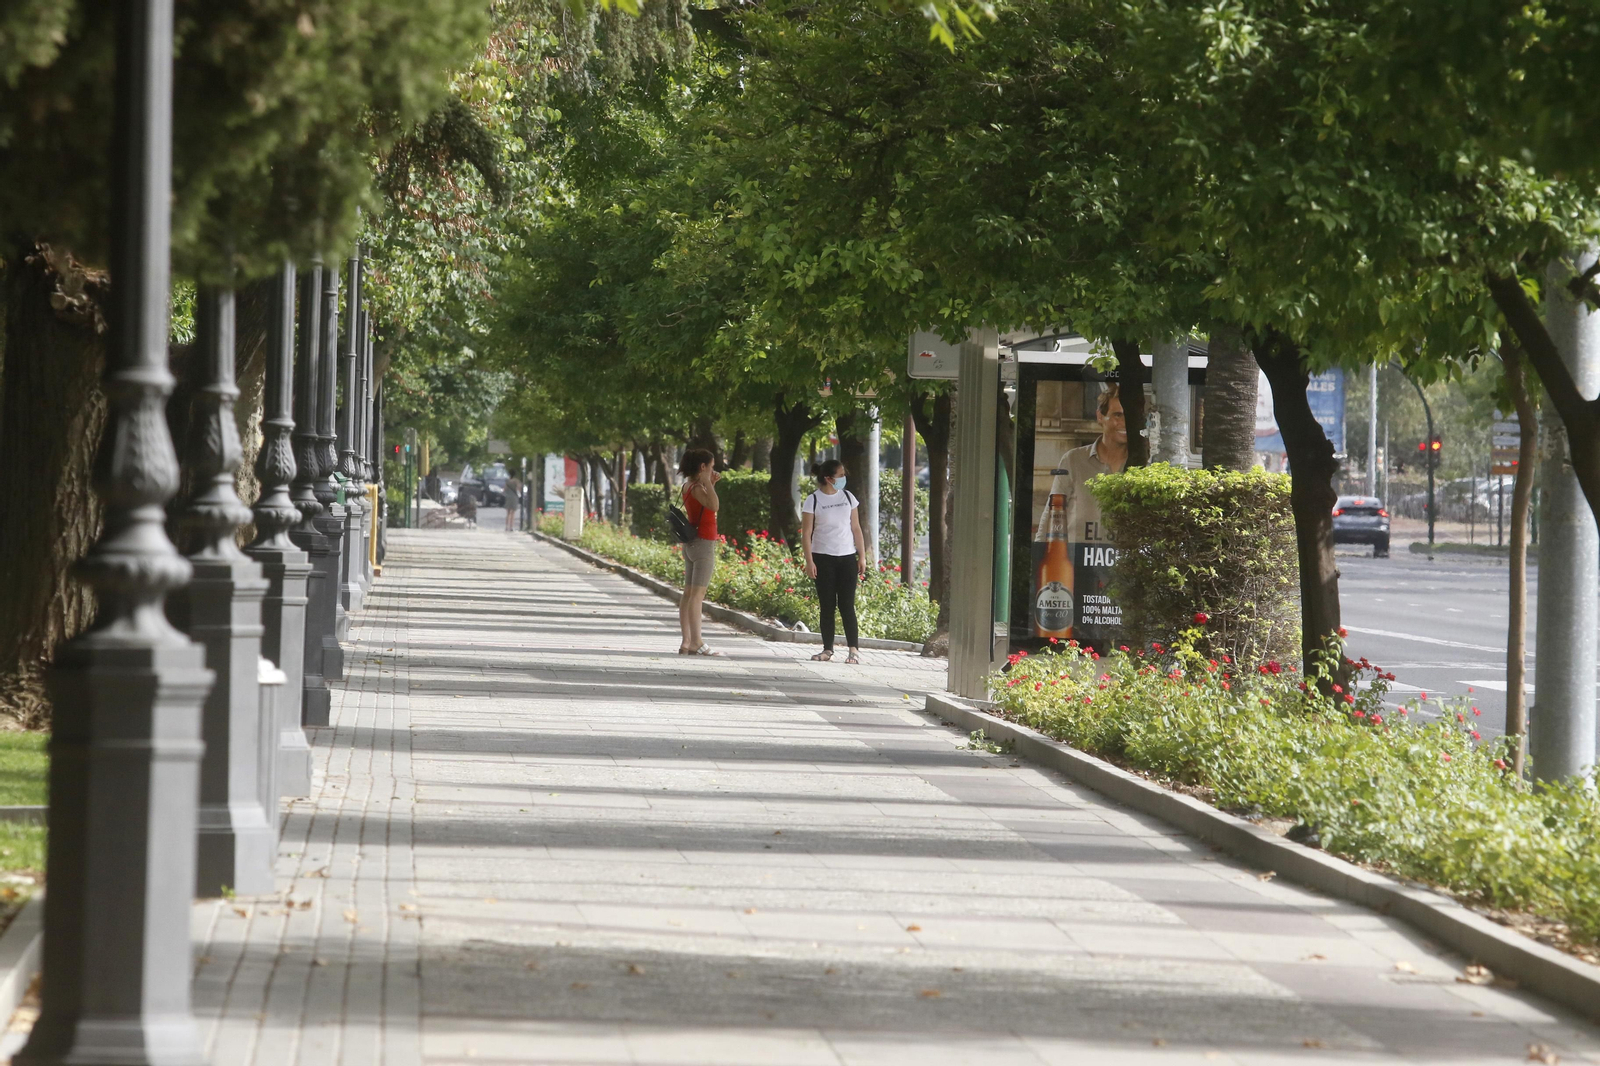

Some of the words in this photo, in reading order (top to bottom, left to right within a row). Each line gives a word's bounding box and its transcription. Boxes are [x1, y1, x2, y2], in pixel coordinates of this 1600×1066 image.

[1085, 522, 1102, 540] EL
[1038, 600, 1071, 608] AMSTEL
[1082, 594, 1111, 604] TOSTADA
[1082, 605, 1100, 614] 100%
[1101, 606, 1123, 615] MALTA
[1082, 615, 1093, 624] 0%
[1093, 616, 1122, 625] ALCOHOL
